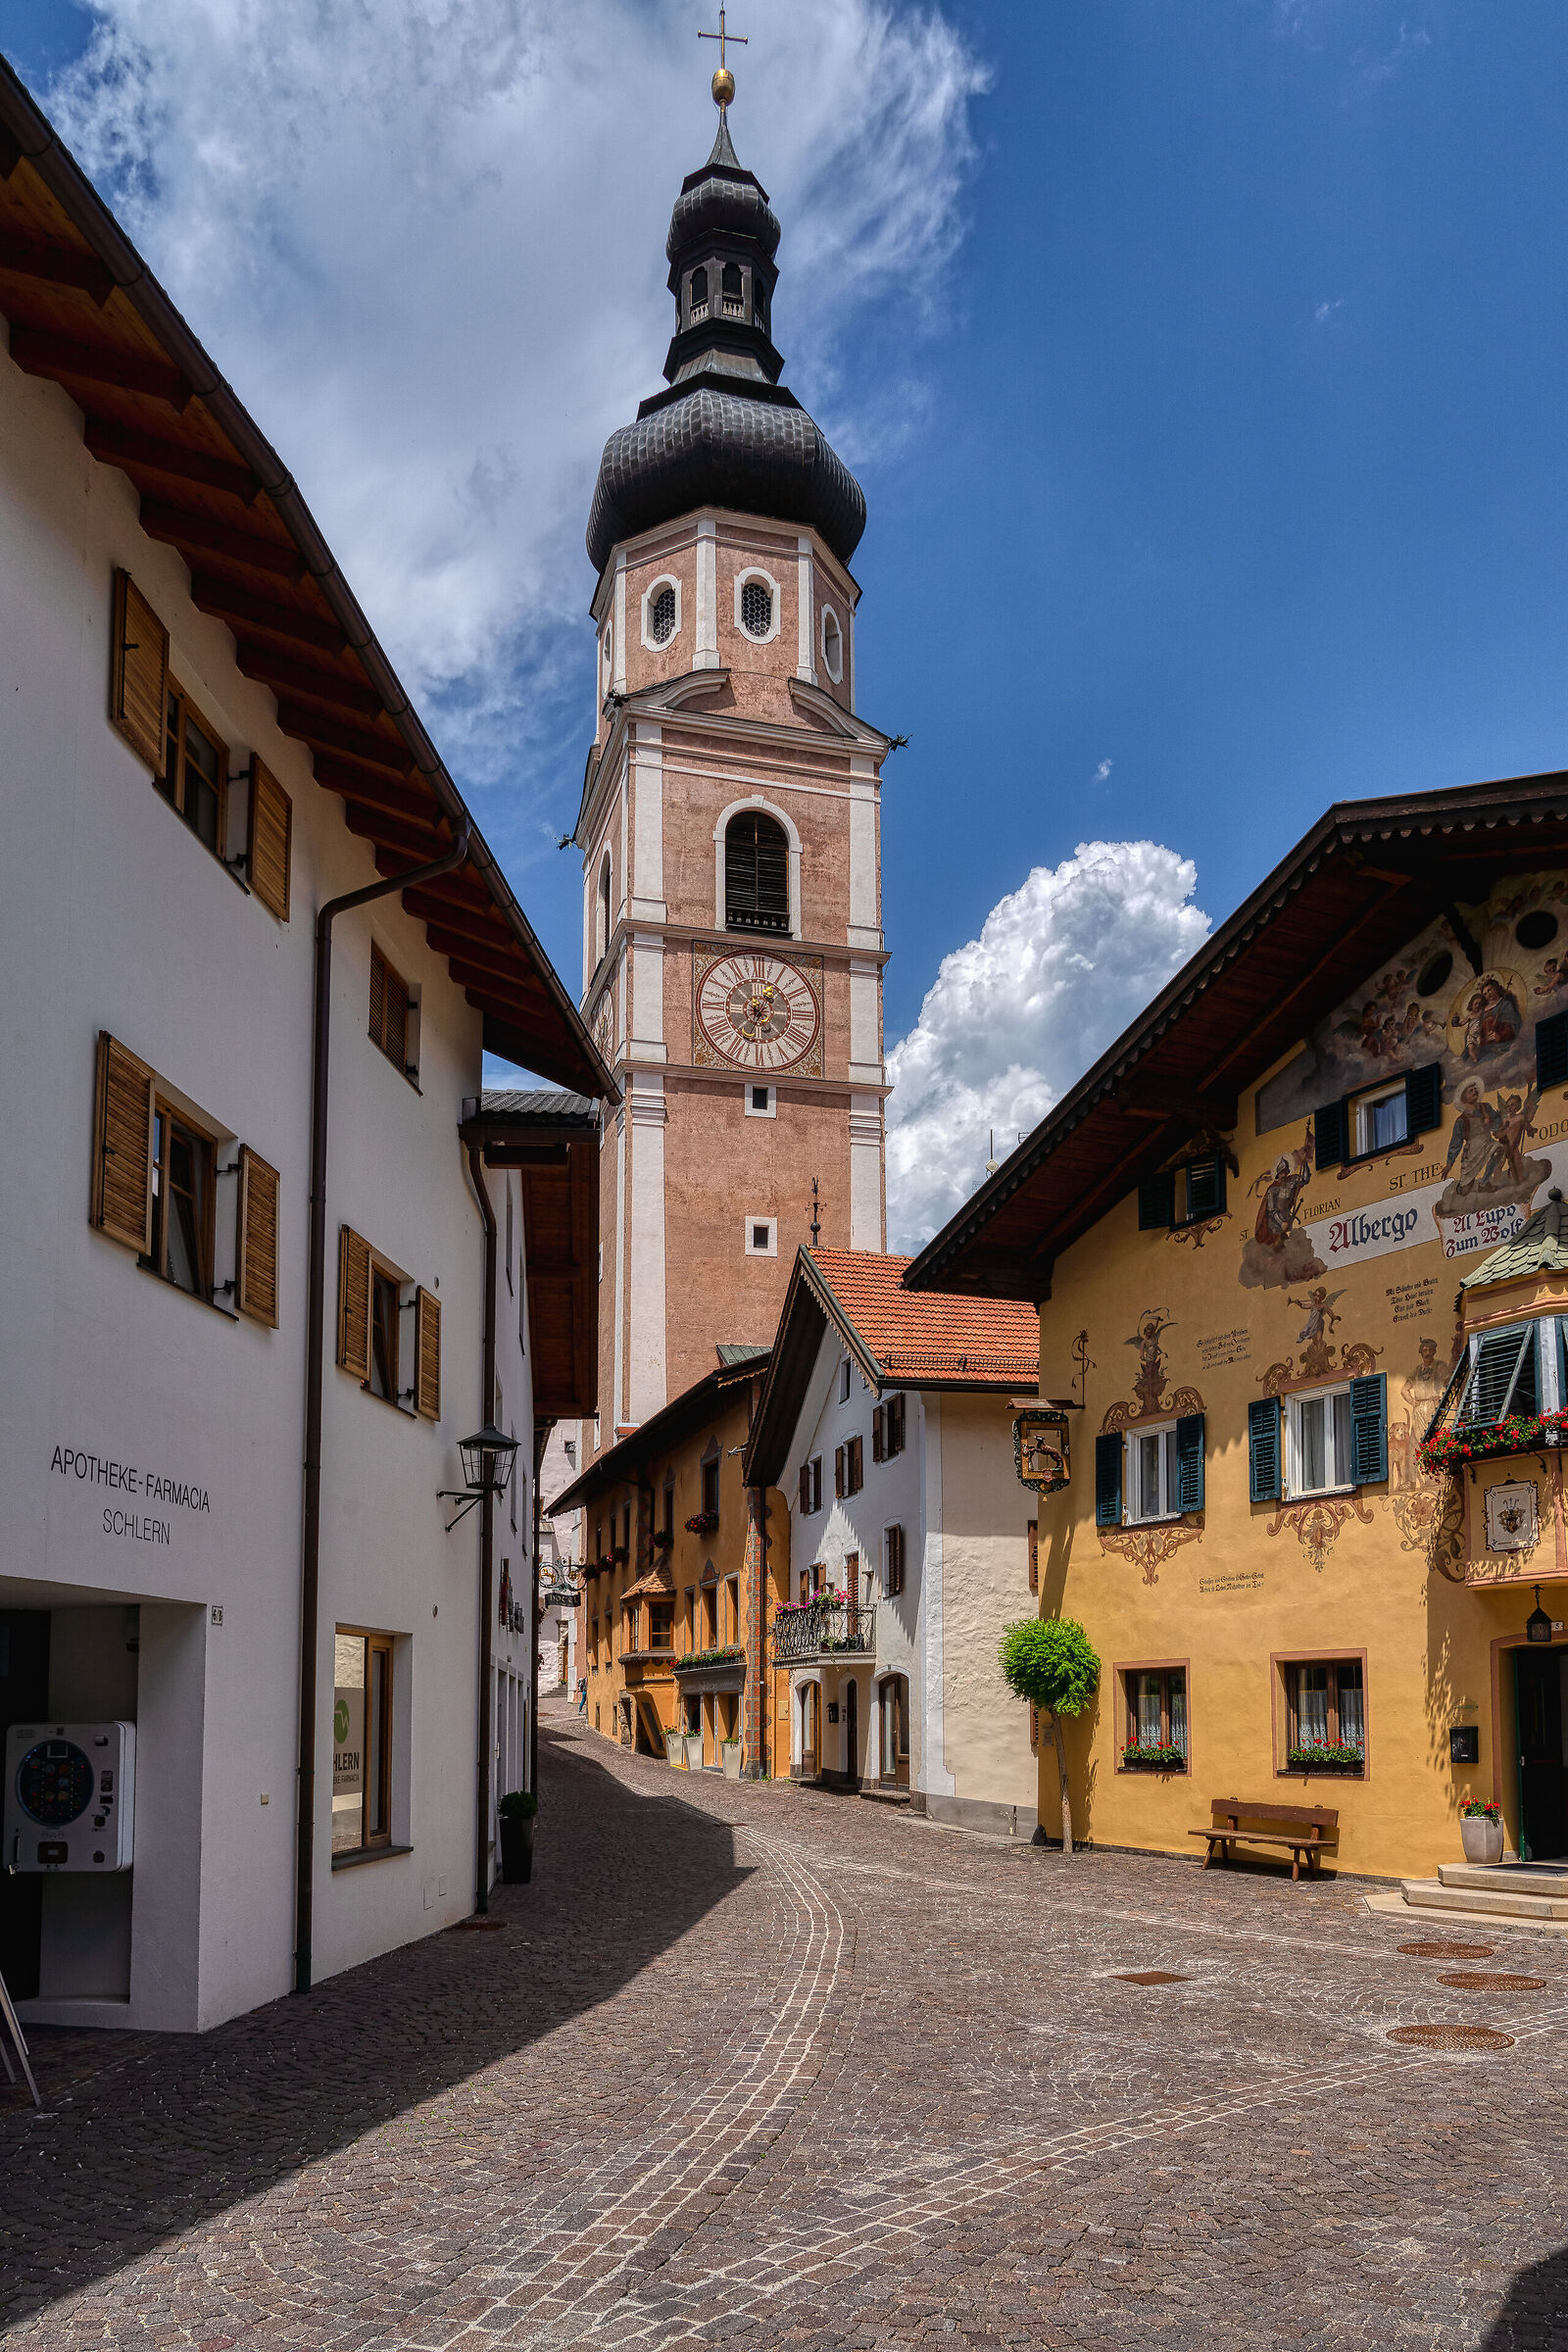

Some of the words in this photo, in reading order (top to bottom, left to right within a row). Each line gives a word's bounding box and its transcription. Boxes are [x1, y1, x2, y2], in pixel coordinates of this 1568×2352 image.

[1303, 1199, 1341, 1220] FLORIAN
[1453, 1215, 1471, 1233] Al
[1476, 1204, 1516, 1227] Lupo
[1329, 1207, 1418, 1253] Albergo
[1446, 1236, 1479, 1258] Zum
[1481, 1217, 1524, 1244] Wolf
[103, 1508, 171, 1545] SCHLERN
